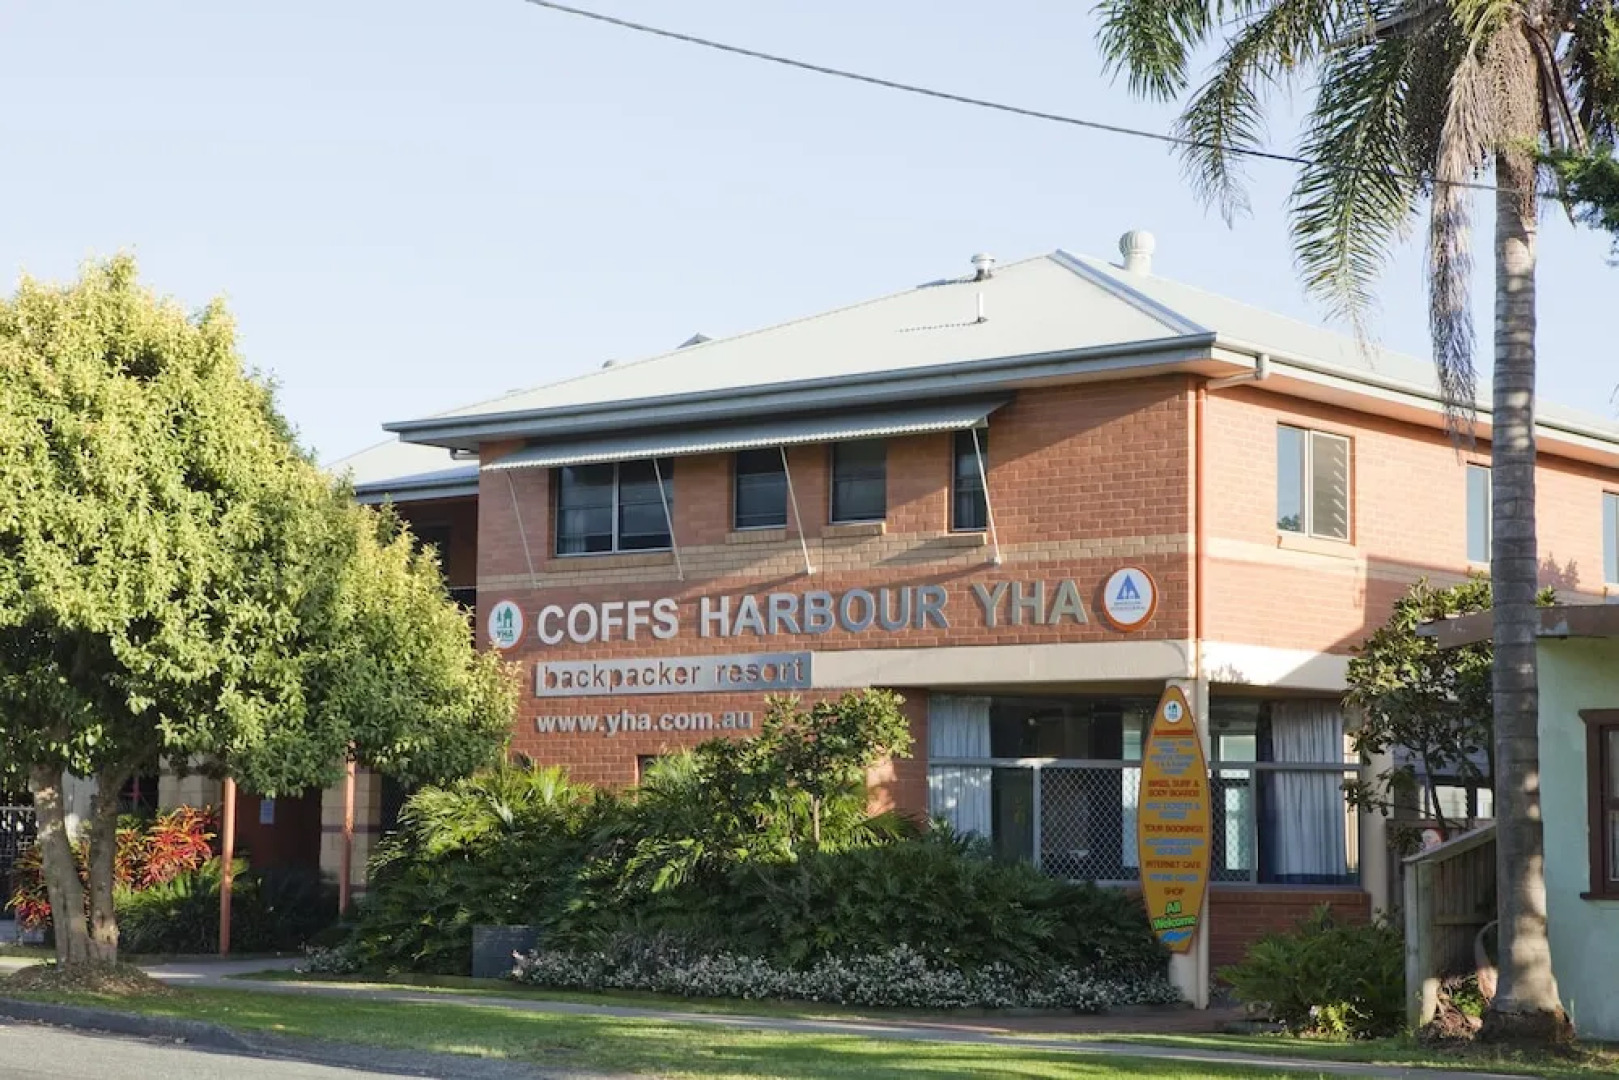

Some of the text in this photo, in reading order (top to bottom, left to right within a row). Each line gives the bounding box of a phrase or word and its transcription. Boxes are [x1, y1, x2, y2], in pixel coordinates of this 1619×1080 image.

[537, 578, 1089, 645] COFFS HARBOUR YHA
[544, 657, 804, 692] backpacker resort
[537, 709, 753, 736] www.yha.com.au
[1166, 825, 1204, 833] BOOKINGS
[1146, 861, 1180, 869] INTERNET
[1164, 887, 1185, 896] SHOP
[1165, 901, 1182, 914] All
[1153, 916, 1197, 930] Welcome
